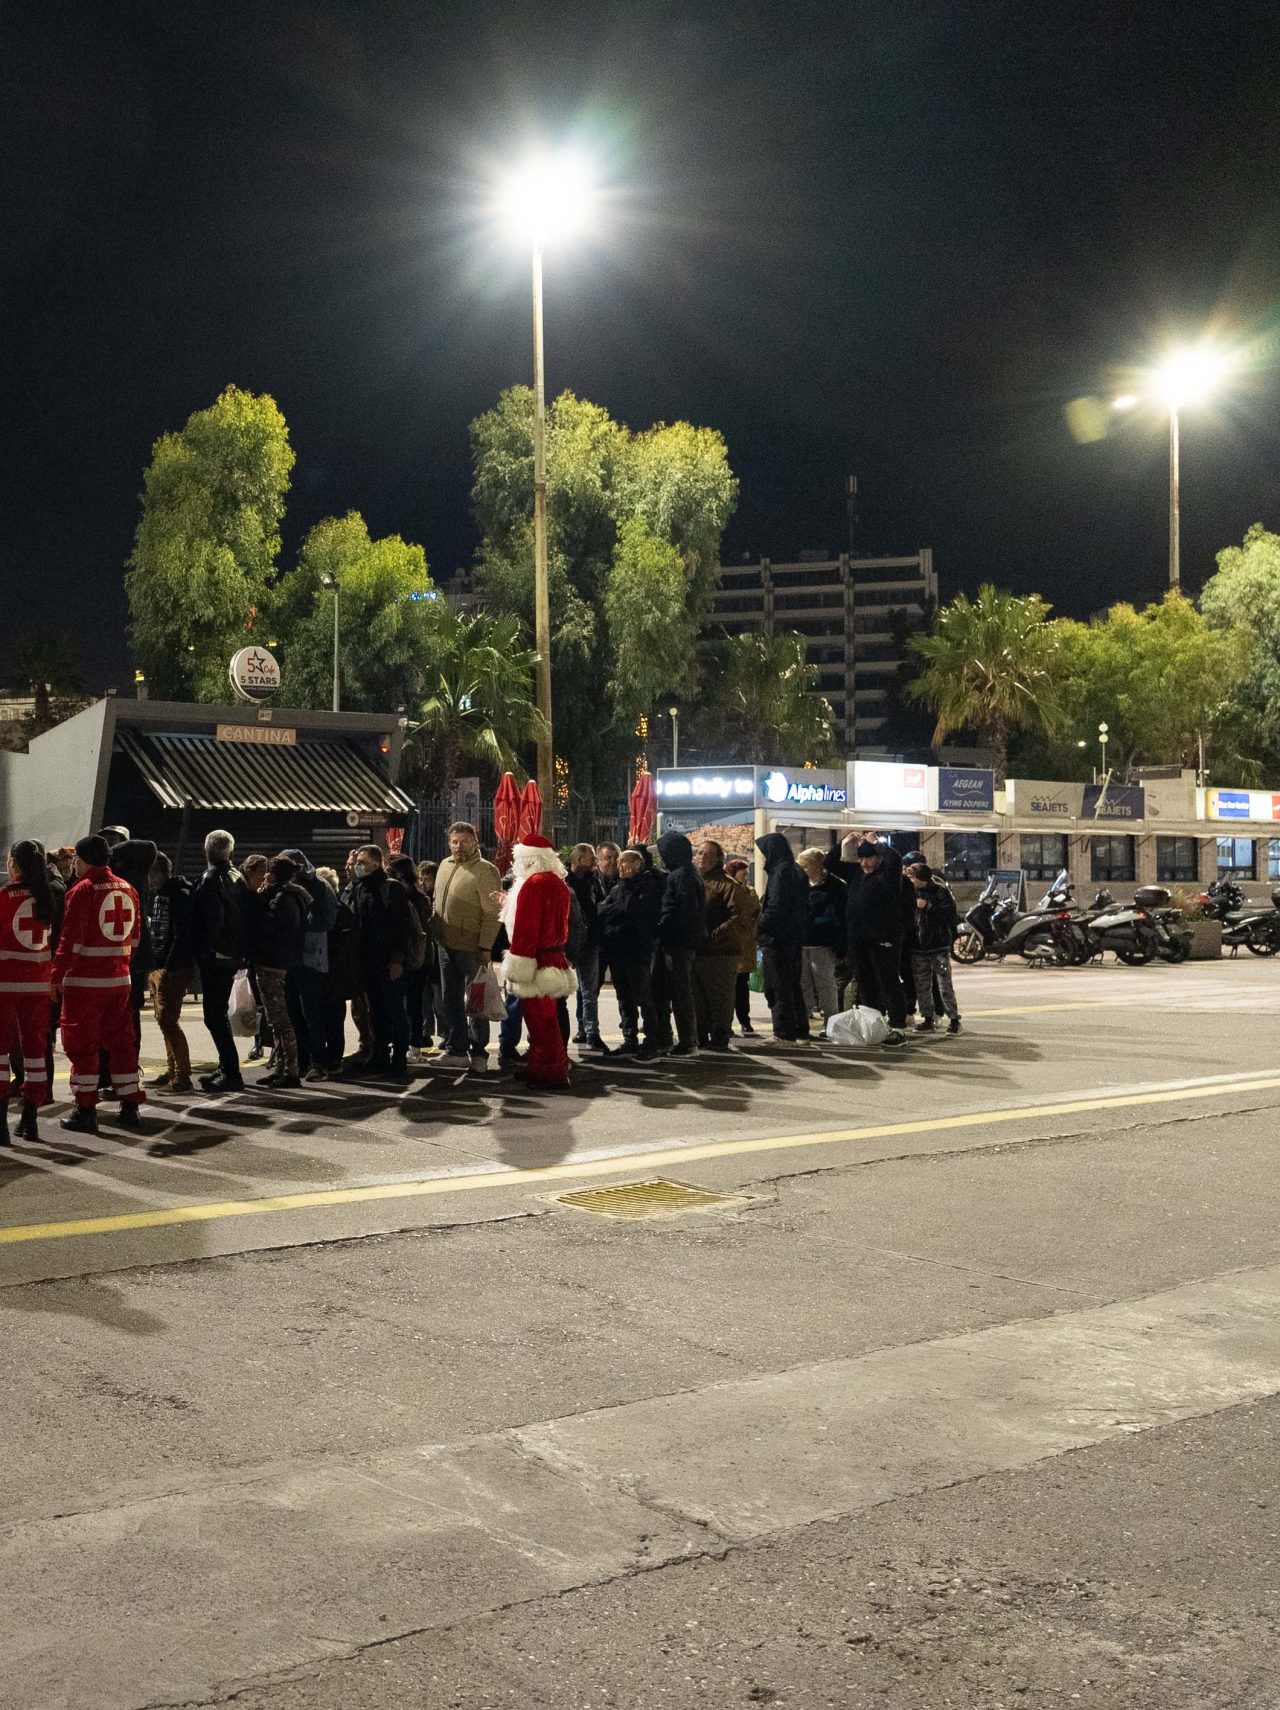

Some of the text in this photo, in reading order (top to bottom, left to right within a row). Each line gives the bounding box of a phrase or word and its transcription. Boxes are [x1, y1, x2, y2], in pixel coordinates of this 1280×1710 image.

[240, 675, 277, 685] 5 STARS
[222, 726, 291, 743] CANTINA
[952, 779, 984, 789] AEGEAN
[787, 783, 846, 804] Alphalines
[1030, 801, 1068, 812] SEAJETS
